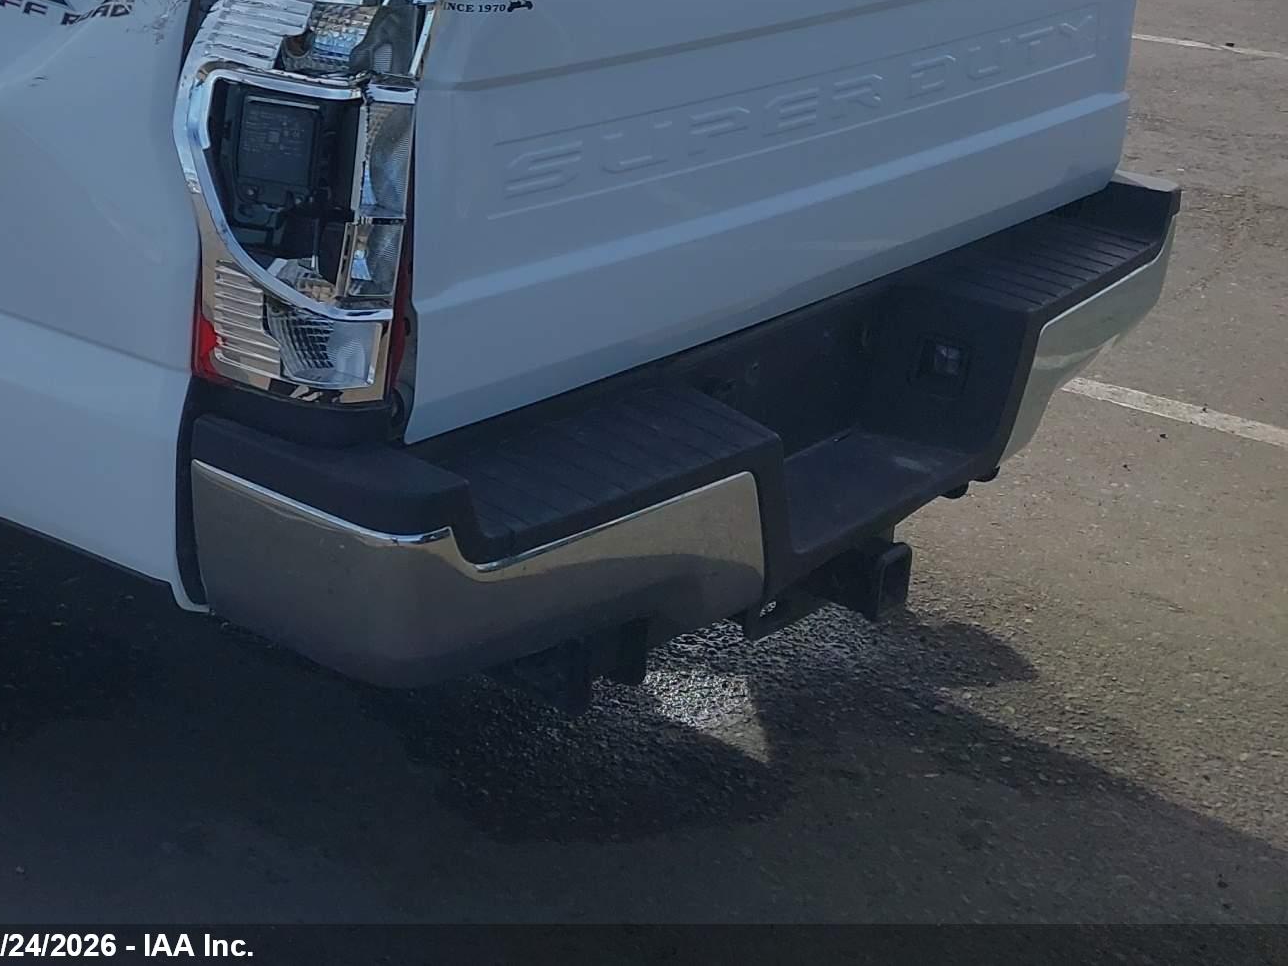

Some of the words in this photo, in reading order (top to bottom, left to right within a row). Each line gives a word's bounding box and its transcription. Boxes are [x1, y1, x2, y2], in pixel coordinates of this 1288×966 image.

[61, 2, 132, 25] RAD
[444, 2, 474, 13] INCE
[479, 4, 505, 13] 1970
[504, 73, 884, 199] SUPER
[906, 15, 1094, 99] DUTY
